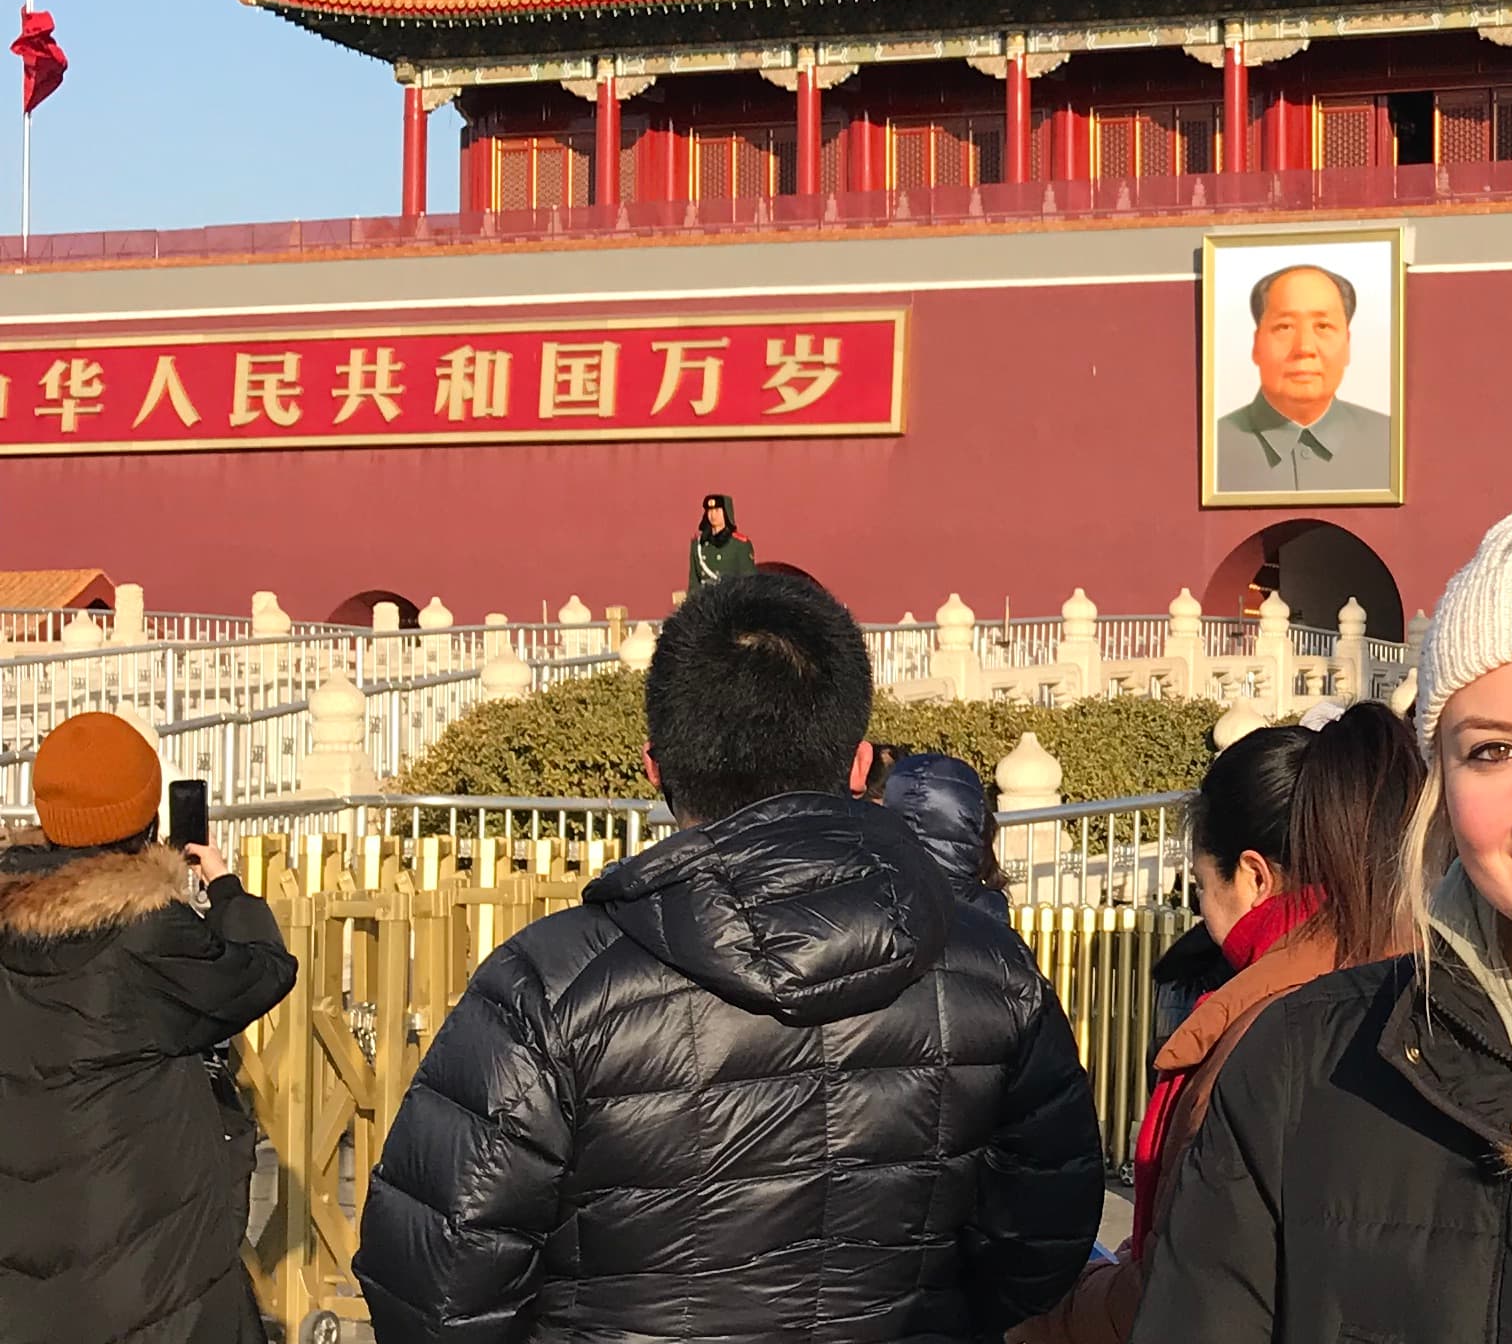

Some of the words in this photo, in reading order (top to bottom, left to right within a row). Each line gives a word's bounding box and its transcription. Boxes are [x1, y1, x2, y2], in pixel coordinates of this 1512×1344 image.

[0, 333, 843, 433] 华人民共和国万岁
